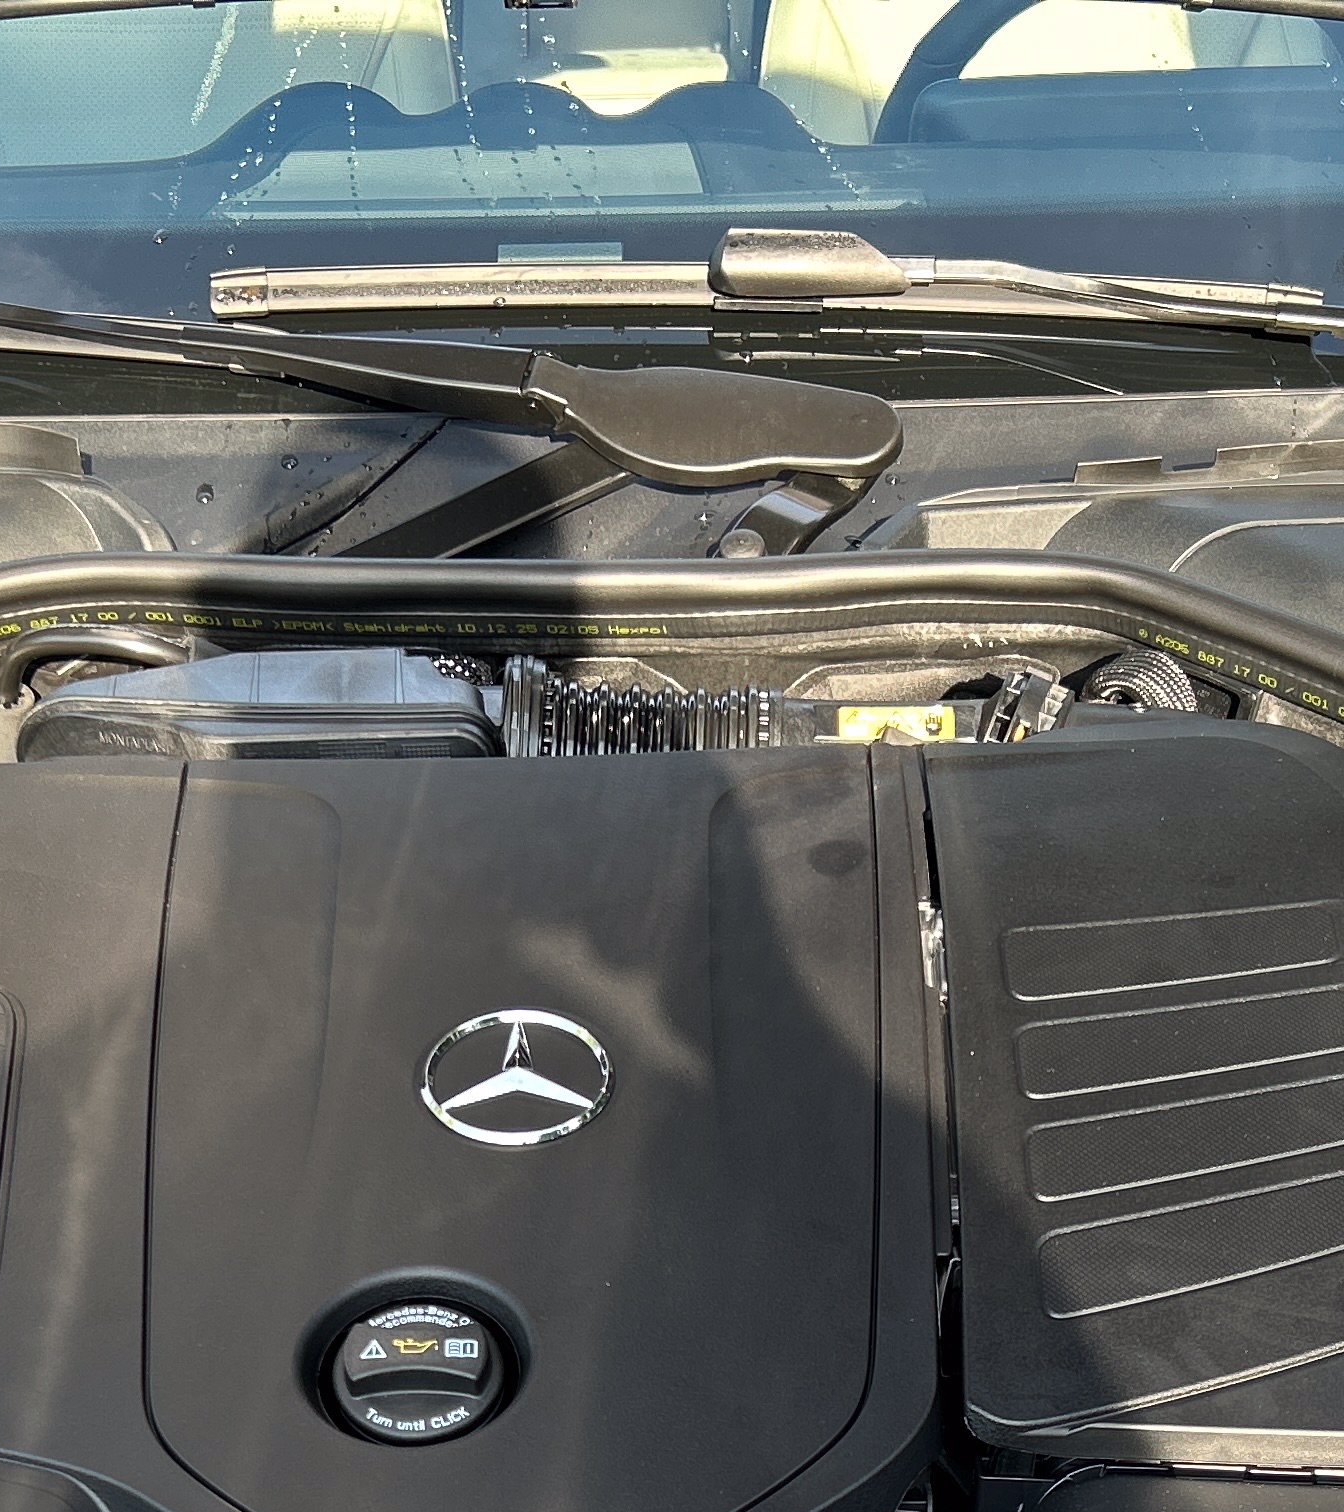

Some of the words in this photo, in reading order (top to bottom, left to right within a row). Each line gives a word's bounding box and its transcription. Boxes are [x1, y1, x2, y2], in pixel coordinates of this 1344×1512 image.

[69, 612, 89, 623] 17
[97, 611, 119, 621] 00
[144, 611, 174, 623] 001
[231, 617, 264, 629] ELP
[343, 621, 446, 634] Stahldraht
[607, 624, 668, 636] Hexpol
[1197, 650, 1225, 668] 887
[1233, 664, 1251, 678] 17
[1258, 673, 1278, 689] 00
[1302, 691, 1329, 711] 001
[365, 1407, 393, 1429] Turn
[396, 1417, 426, 1432] until
[430, 1406, 472, 1430] CLICK
